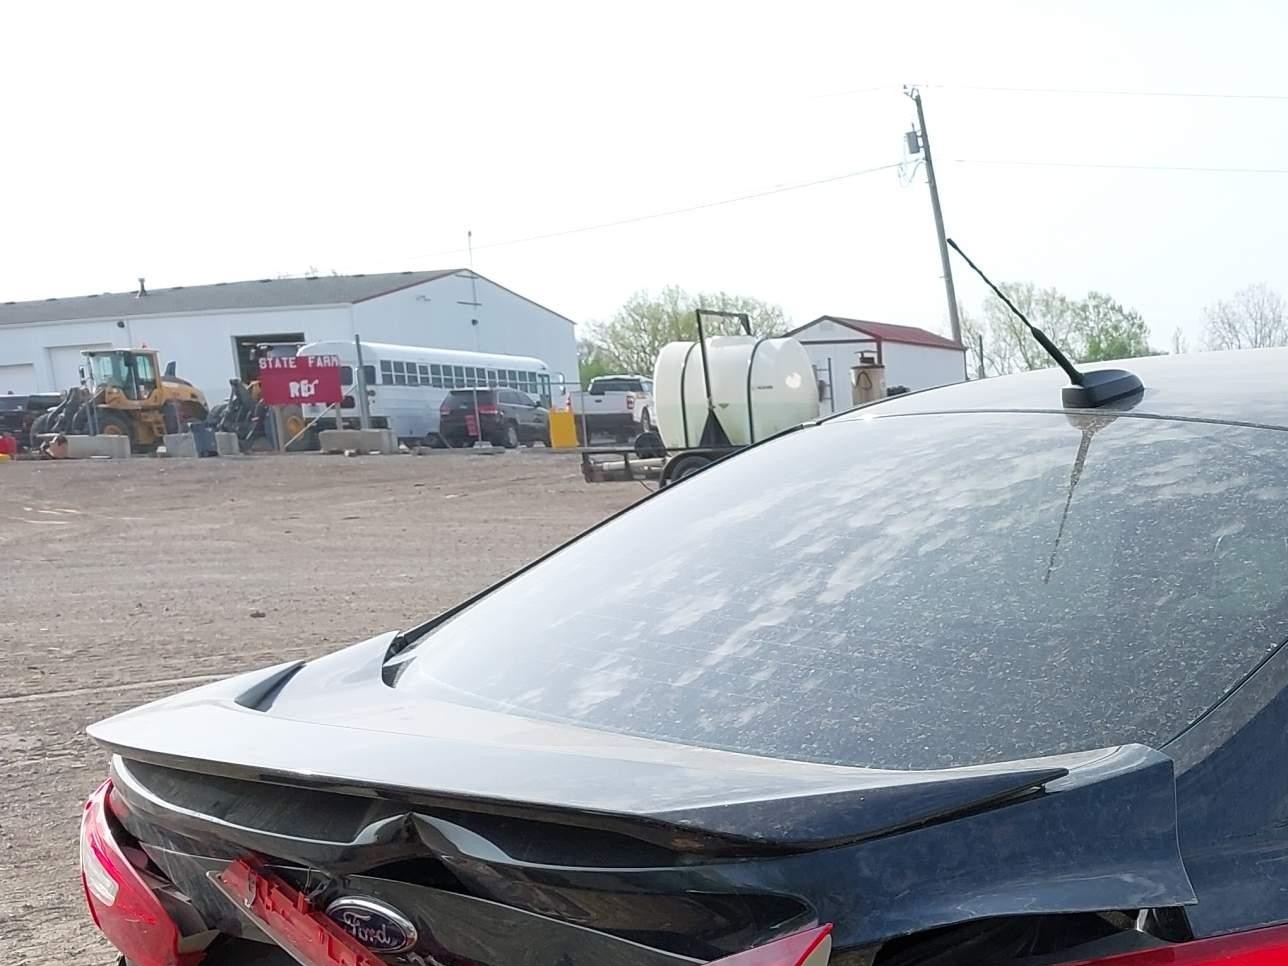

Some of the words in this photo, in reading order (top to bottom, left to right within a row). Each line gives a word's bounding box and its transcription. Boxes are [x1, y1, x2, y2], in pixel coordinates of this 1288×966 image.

[258, 356, 297, 369] STATE
[308, 355, 339, 368] FARM
[343, 911, 391, 945] Ford
